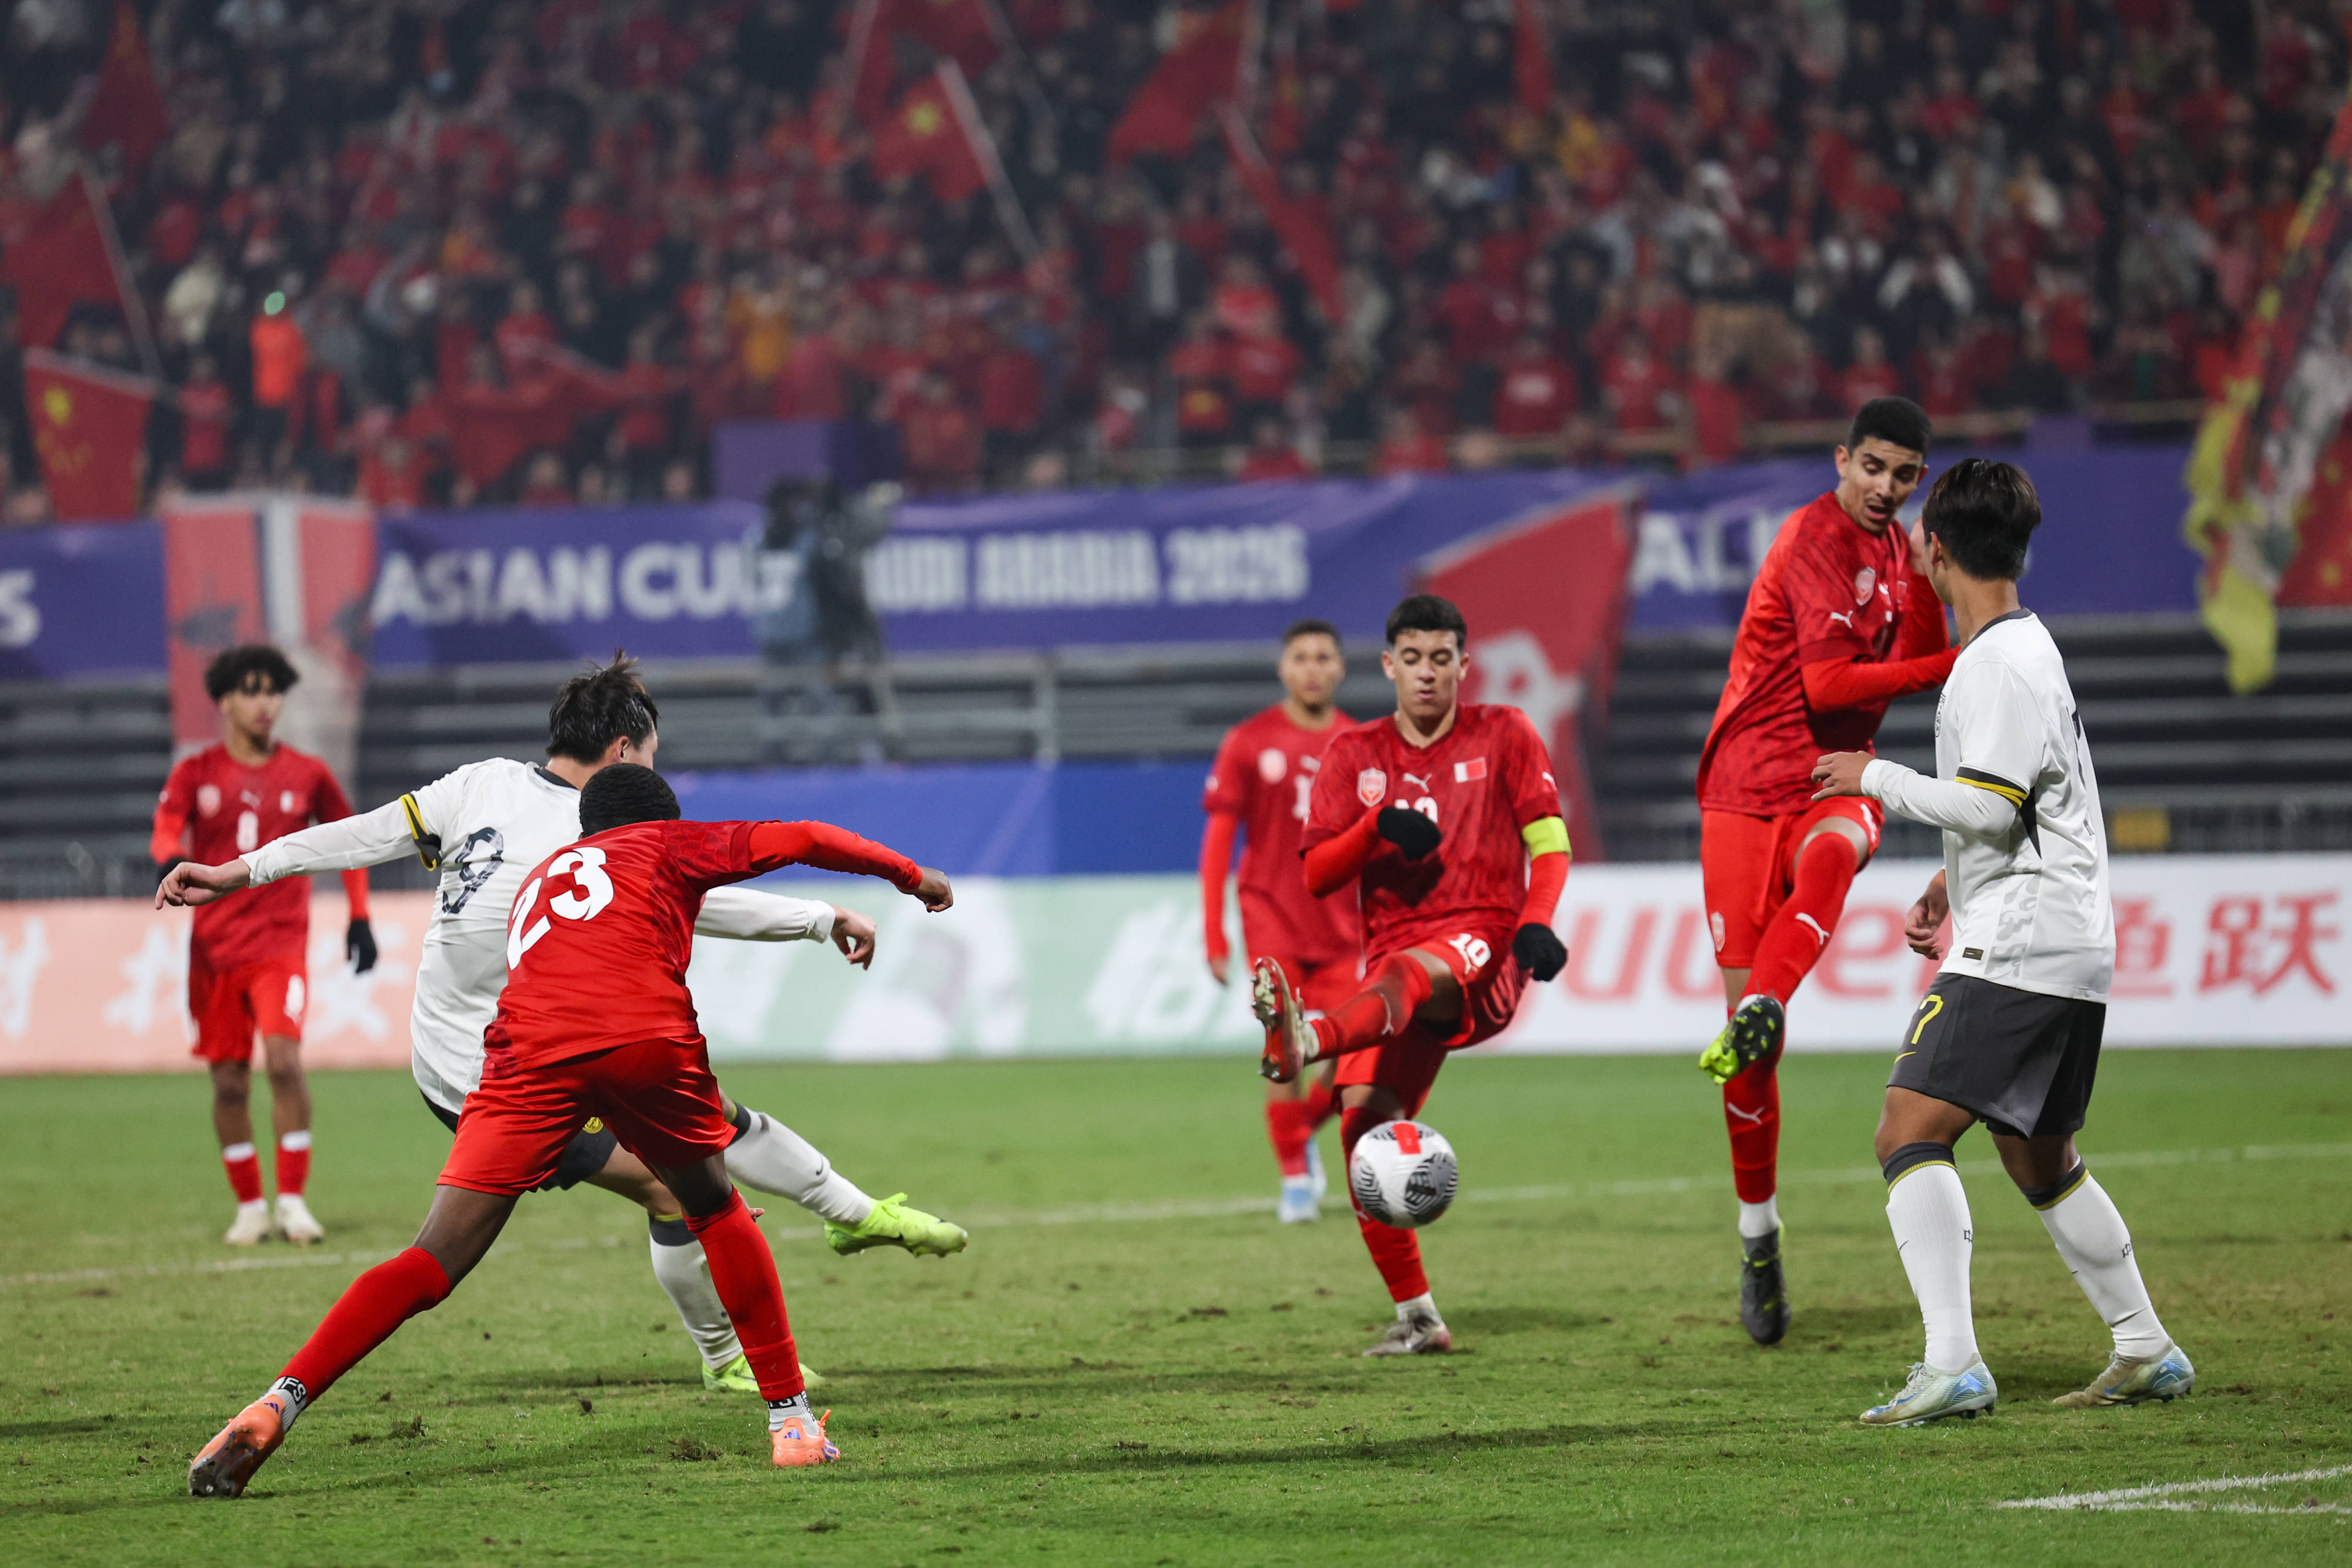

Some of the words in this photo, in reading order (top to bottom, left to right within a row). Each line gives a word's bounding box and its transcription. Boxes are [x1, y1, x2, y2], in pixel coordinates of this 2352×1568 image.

[372, 543, 612, 629] ASIAN
[442, 827, 504, 914] 9
[507, 847, 614, 971] 23
[1448, 933, 1492, 975] 10
[1910, 994, 1944, 1045] 7
[280, 1377, 306, 1402] FS
